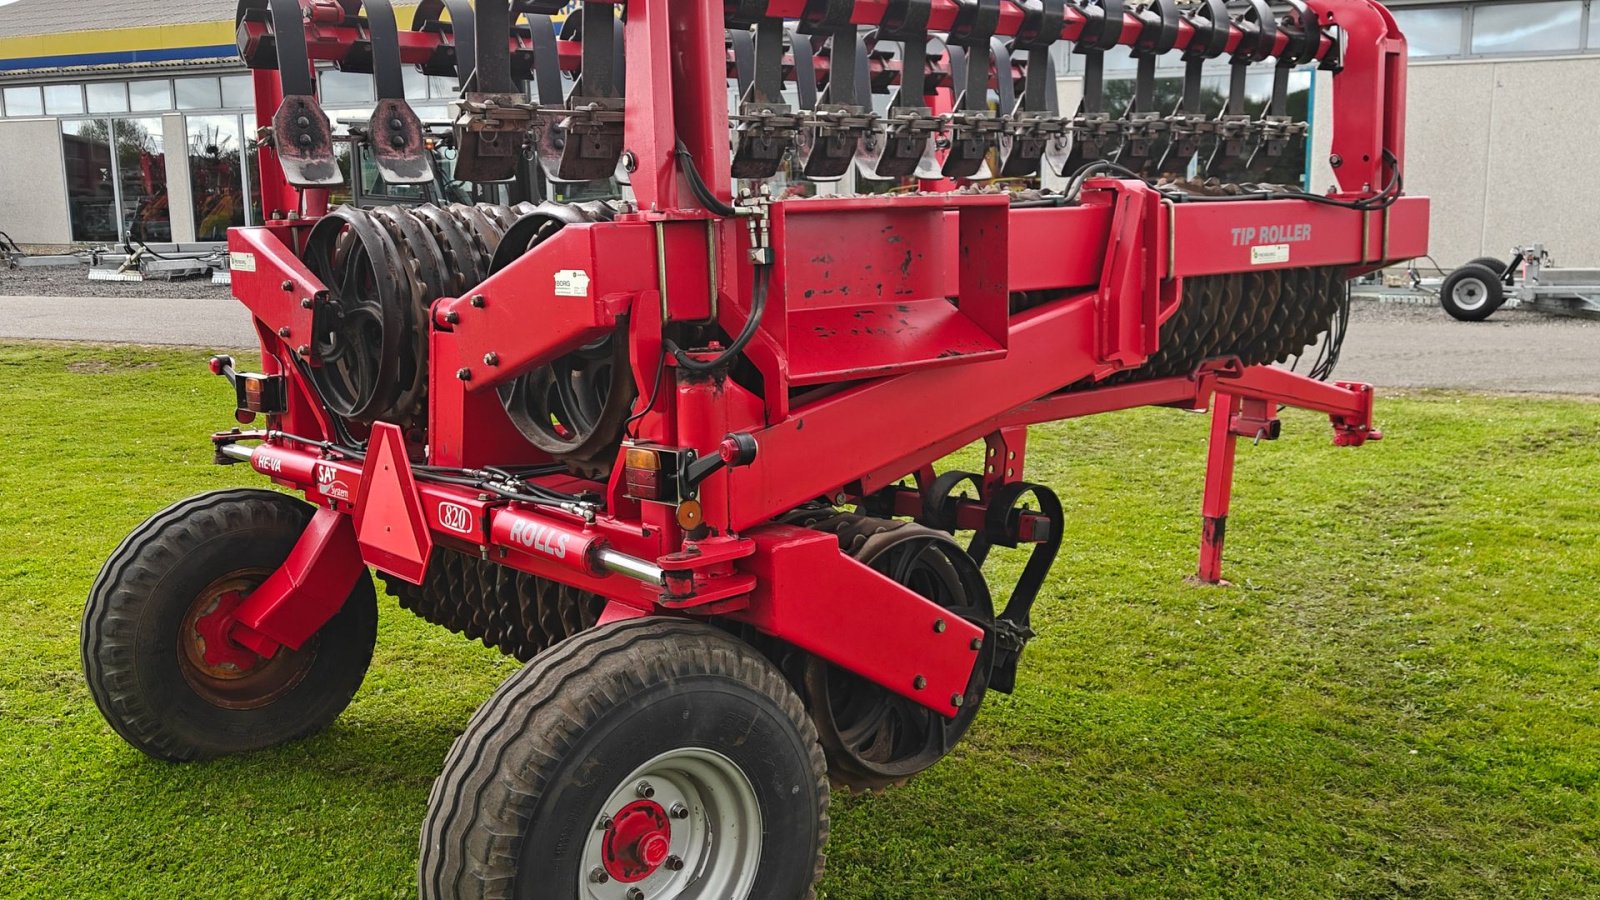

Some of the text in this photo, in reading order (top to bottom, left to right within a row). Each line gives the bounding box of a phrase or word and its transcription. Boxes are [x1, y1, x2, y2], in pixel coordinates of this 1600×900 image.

[1231, 224, 1311, 246] TIP ROLLER
[318, 465, 337, 483] SAT
[445, 505, 466, 530] 820
[510, 519, 570, 558] ROLLS
